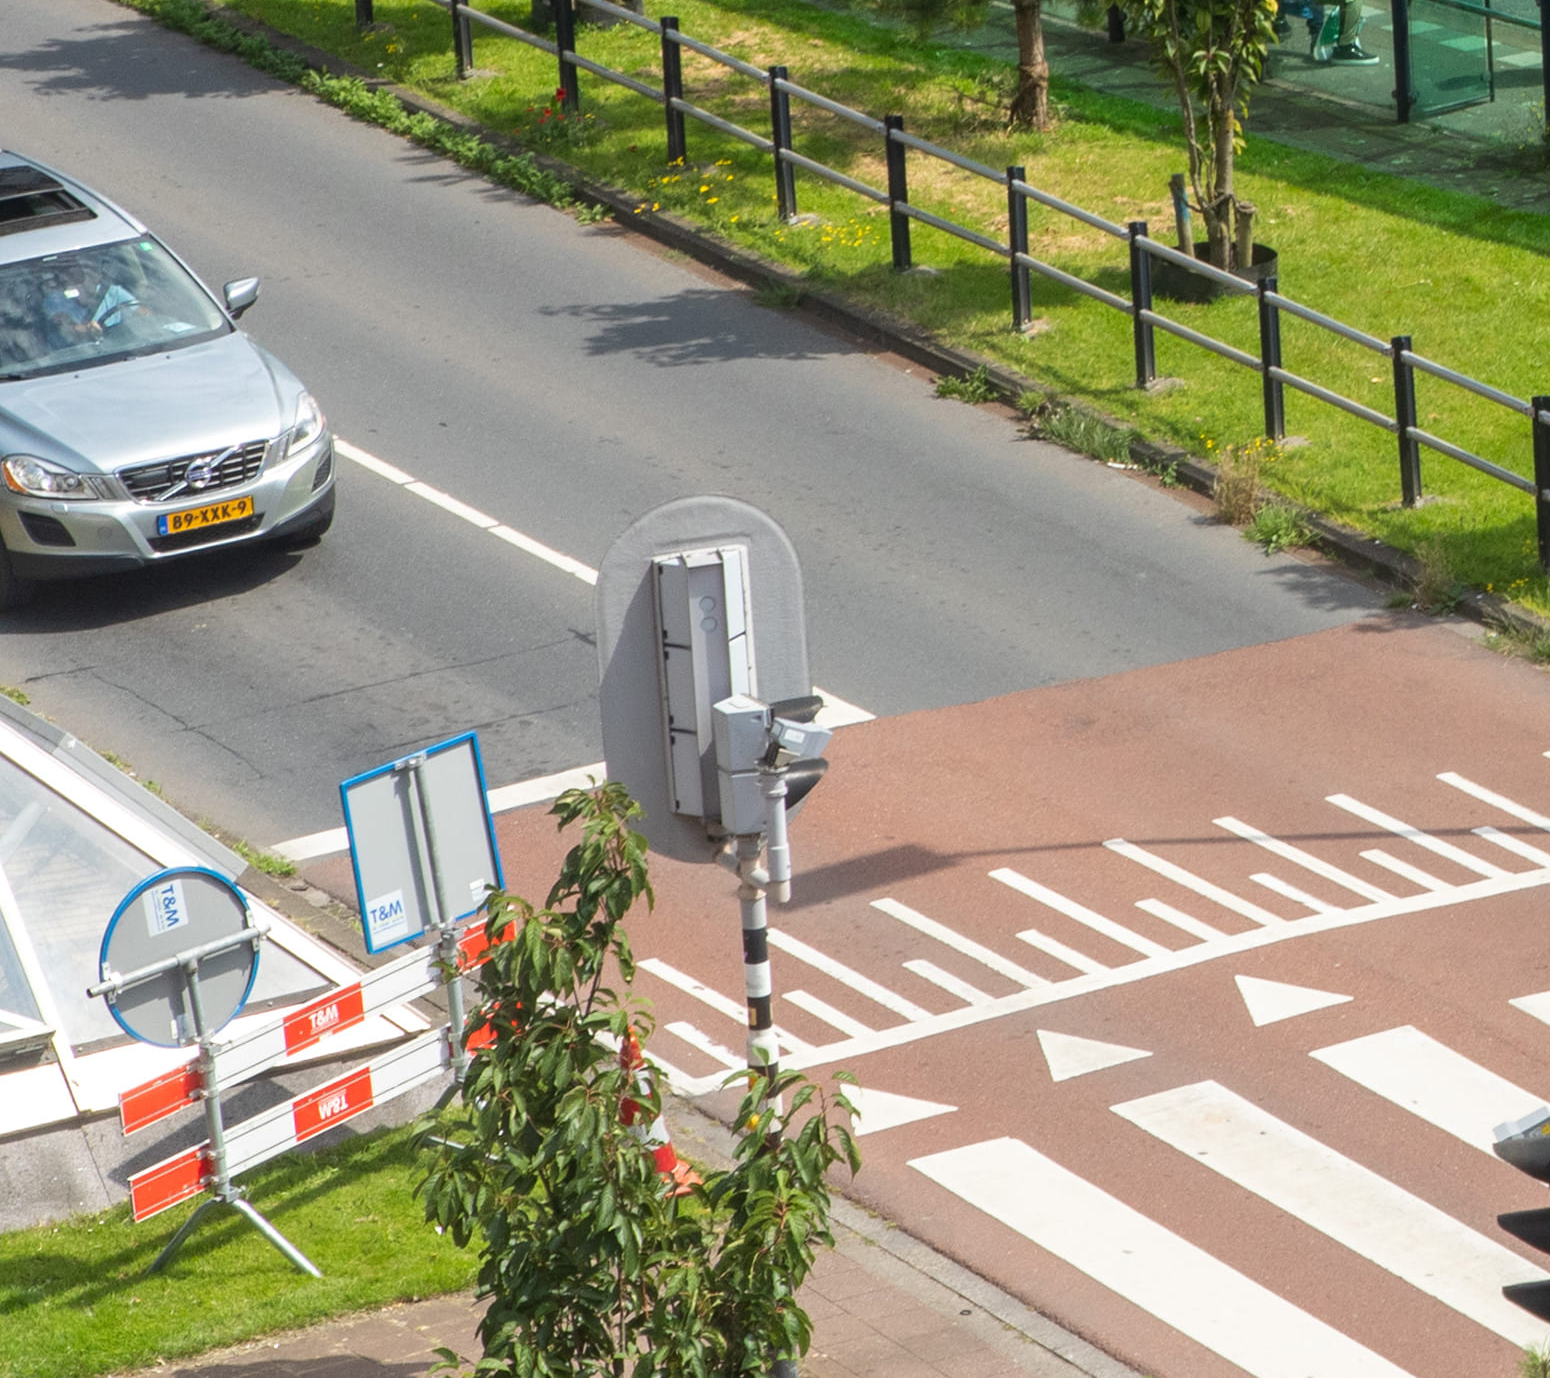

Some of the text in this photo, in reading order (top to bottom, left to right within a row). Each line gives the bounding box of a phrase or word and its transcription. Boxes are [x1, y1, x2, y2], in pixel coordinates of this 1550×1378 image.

[173, 500, 247, 530] 89-XXK-9
[161, 884, 179, 927] T&M
[370, 900, 402, 924] T&M
[308, 1004, 339, 1029] T&M
[318, 1092, 349, 1120] T&M
